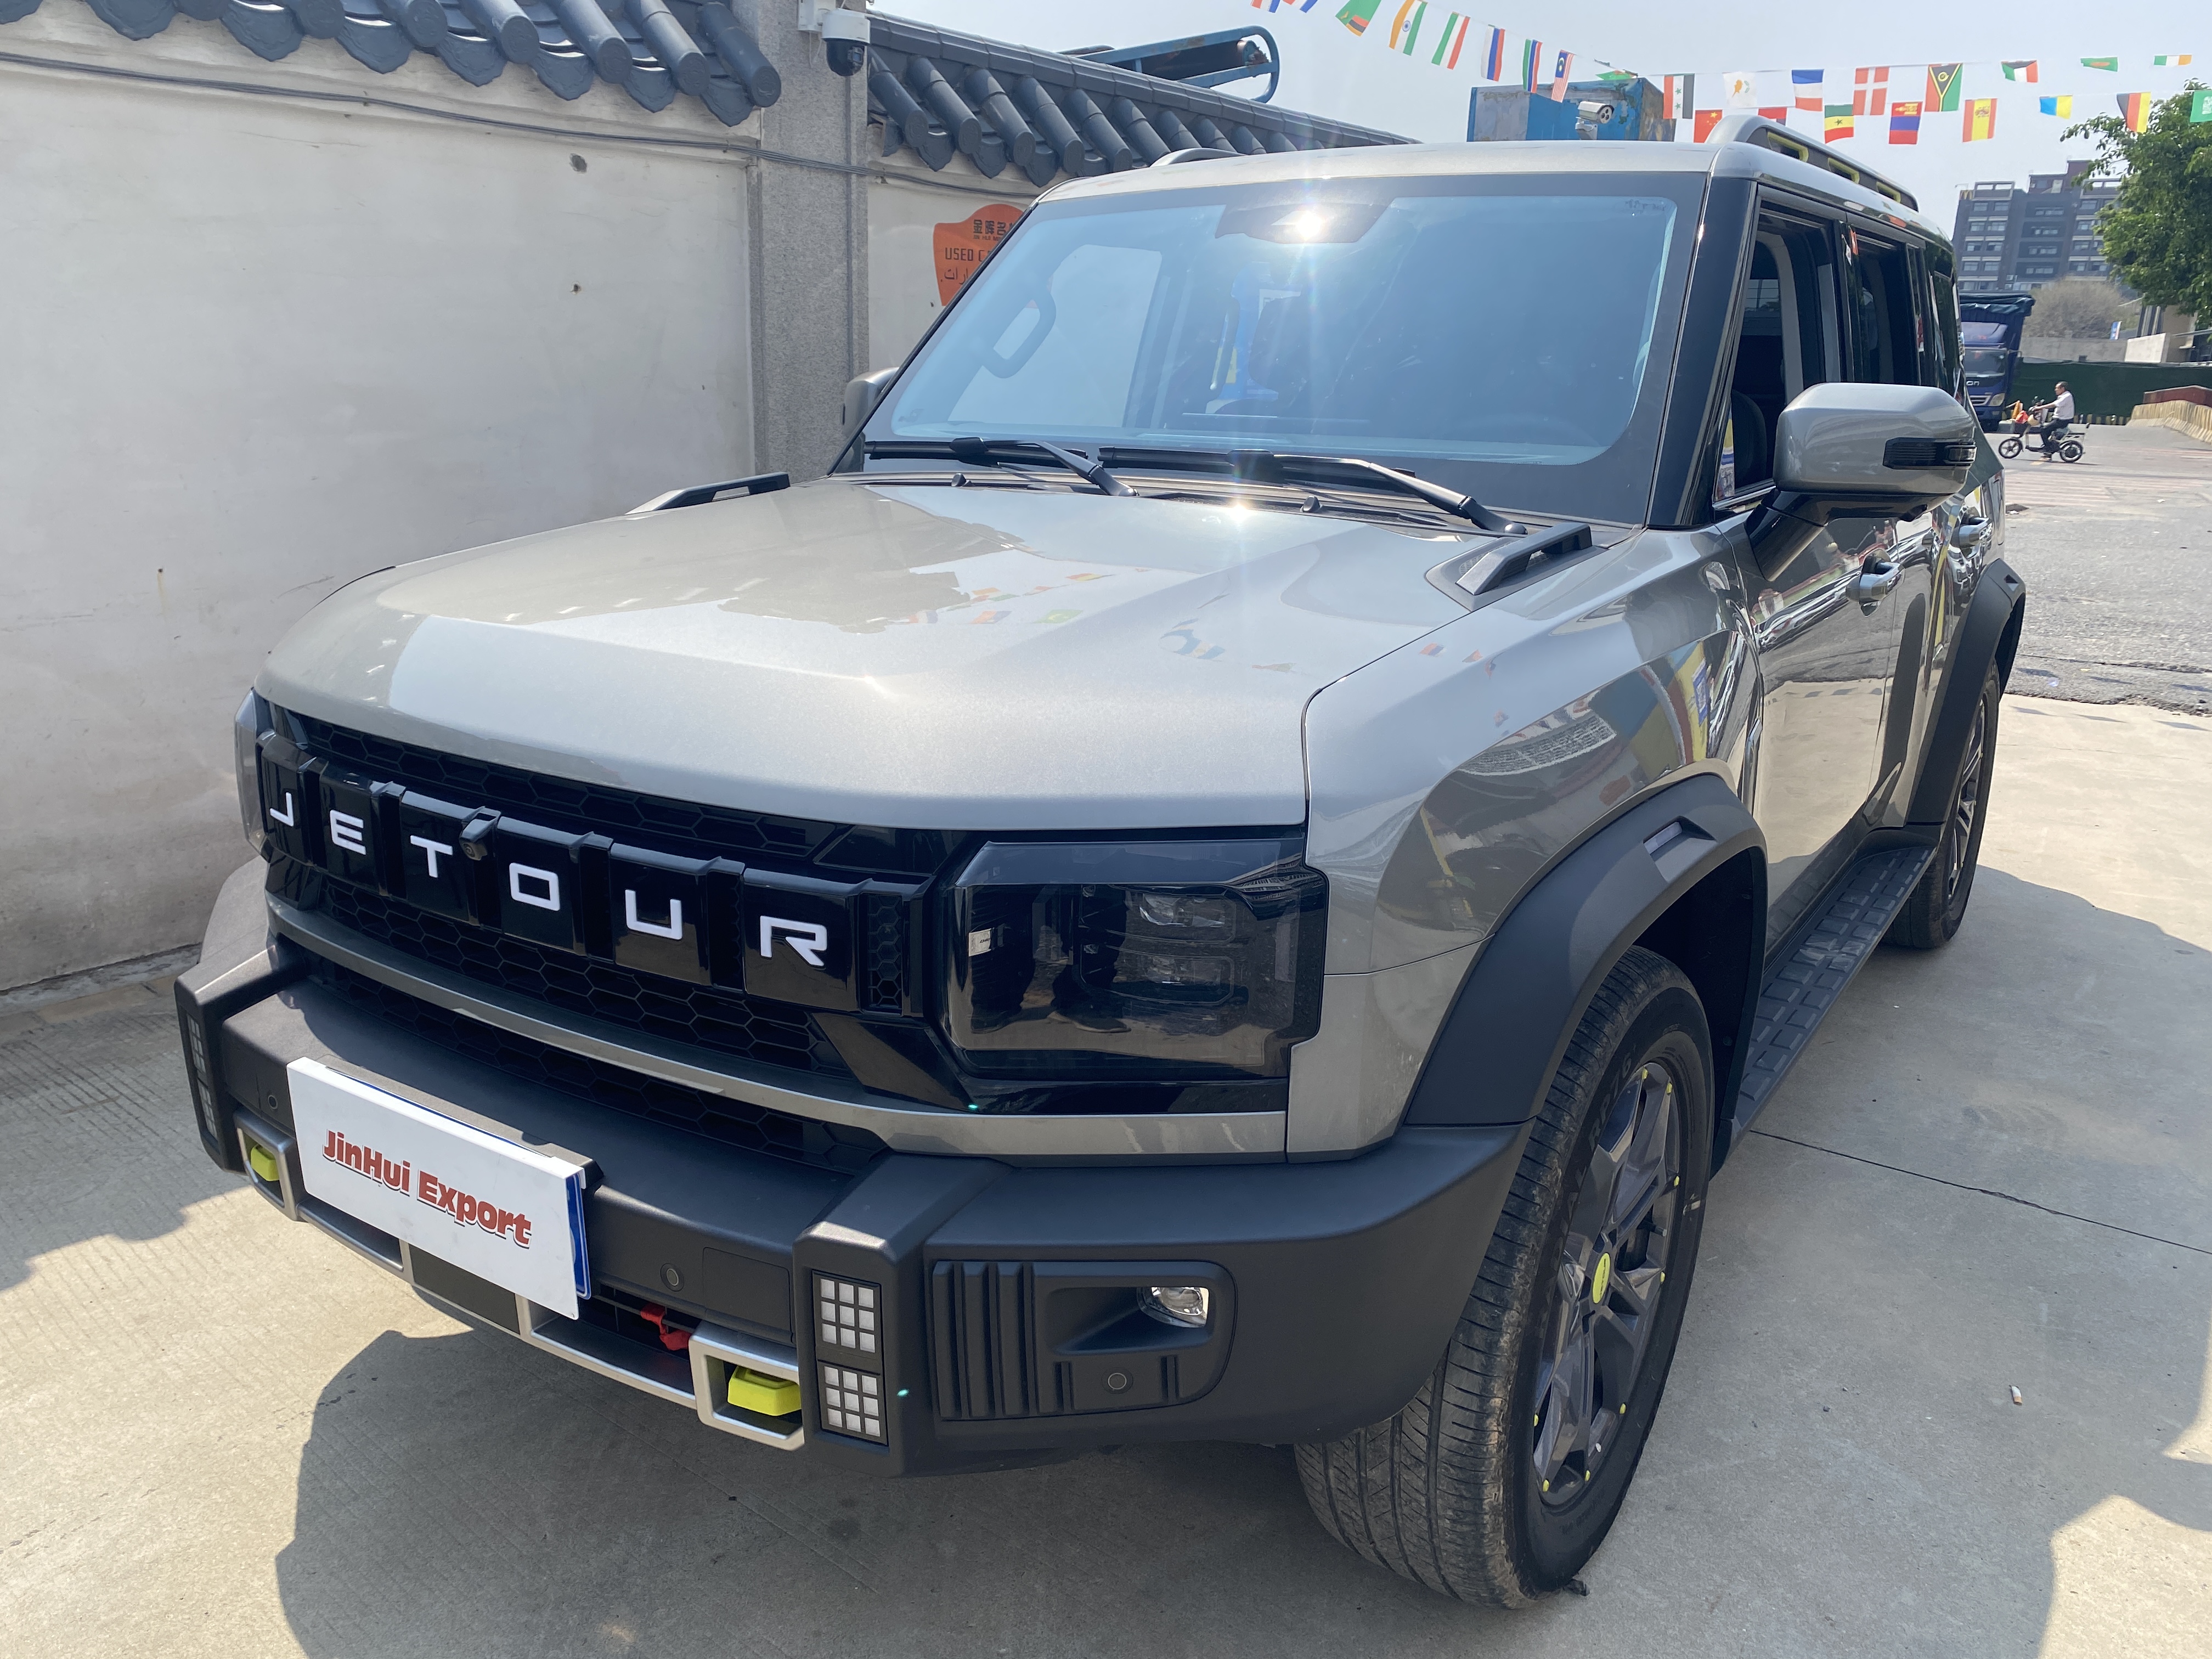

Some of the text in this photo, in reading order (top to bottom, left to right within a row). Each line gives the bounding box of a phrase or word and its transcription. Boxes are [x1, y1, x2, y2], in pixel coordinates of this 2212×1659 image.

[945, 247, 990, 262] USED C
[973, 219, 1014, 235] 金晖名
[269, 792, 828, 967] JETOUR
[323, 1128, 532, 1249] JinHui Export
